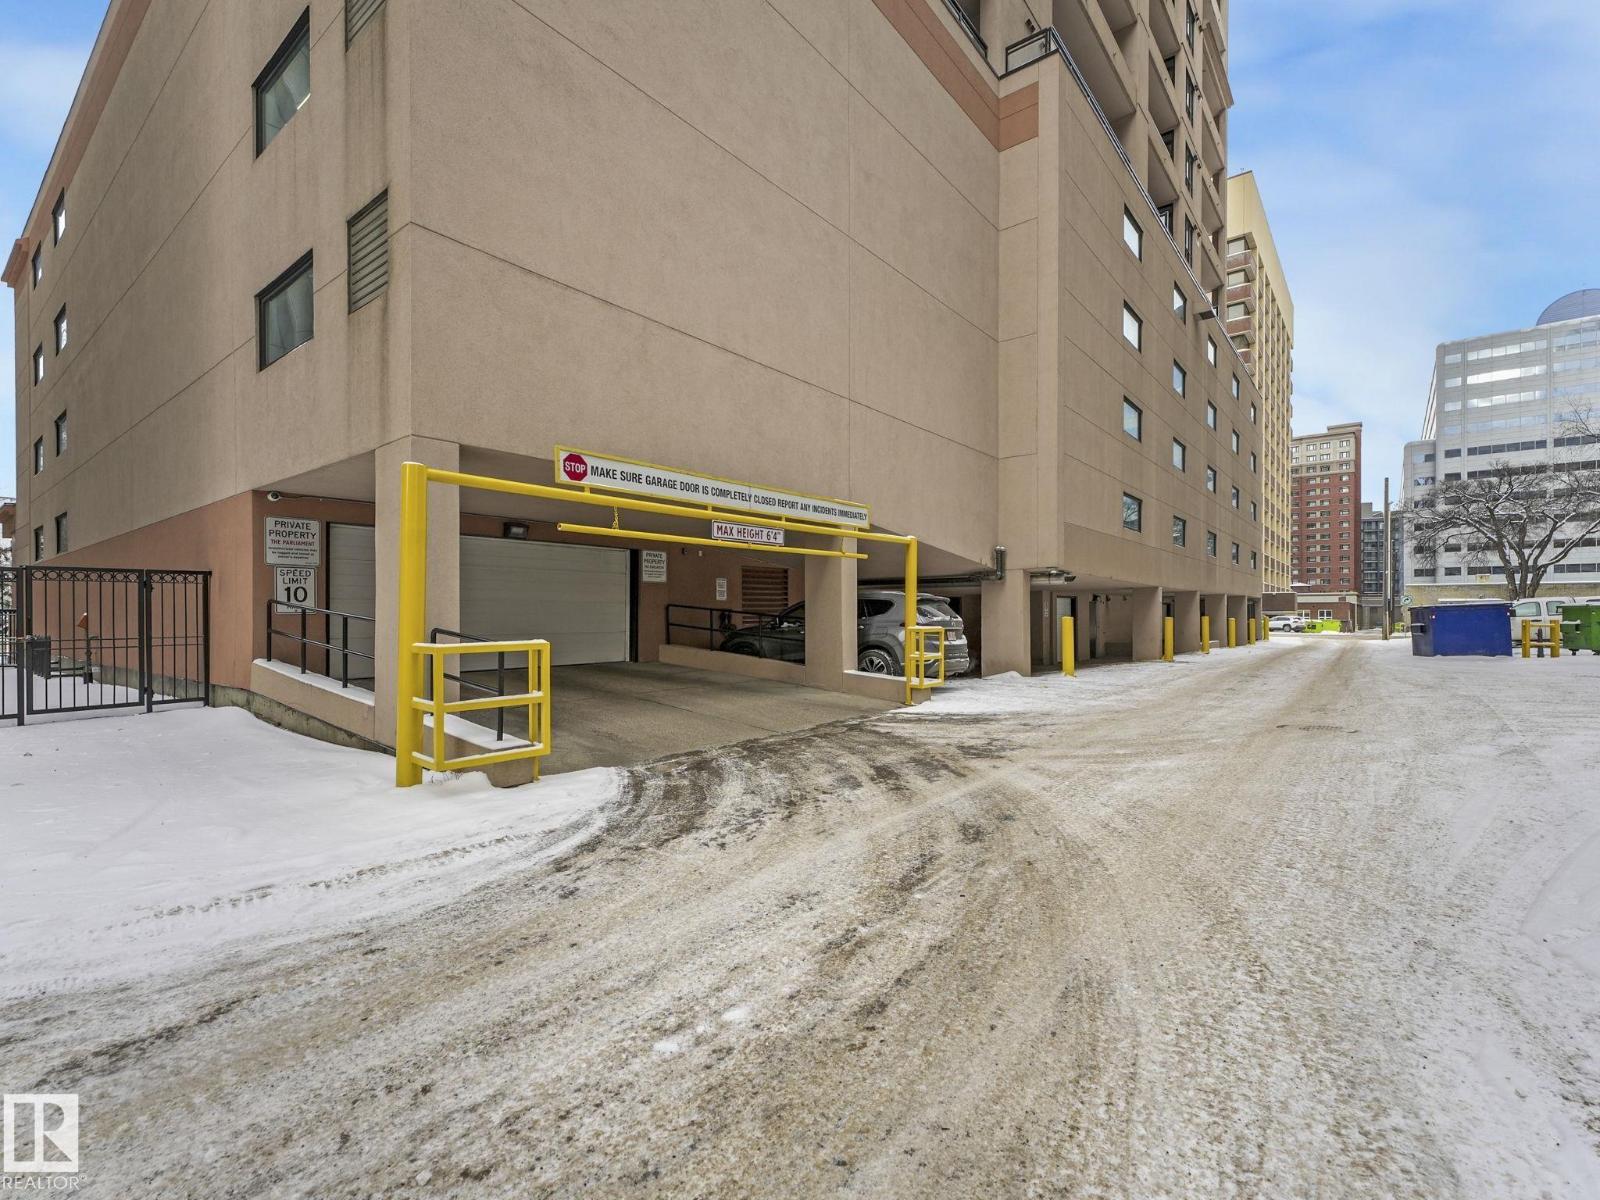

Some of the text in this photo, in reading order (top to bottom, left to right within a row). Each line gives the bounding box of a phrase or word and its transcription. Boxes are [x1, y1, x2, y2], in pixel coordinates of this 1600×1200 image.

[564, 461, 586, 474] STOP
[590, 465, 867, 521] MAKE SURE GARAGE DOOR IS COMPLETELY CLOSED REPORT ANY INCIDENTS IMMEDIATELY
[274, 520, 312, 531] PRIVATE
[268, 529, 317, 539] PROPERTY
[716, 524, 734, 537] MAX
[736, 527, 764, 540] HEIGHT
[279, 569, 312, 577] SPEED
[282, 577, 308, 585] LIMIT
[284, 586, 308, 603] 10
